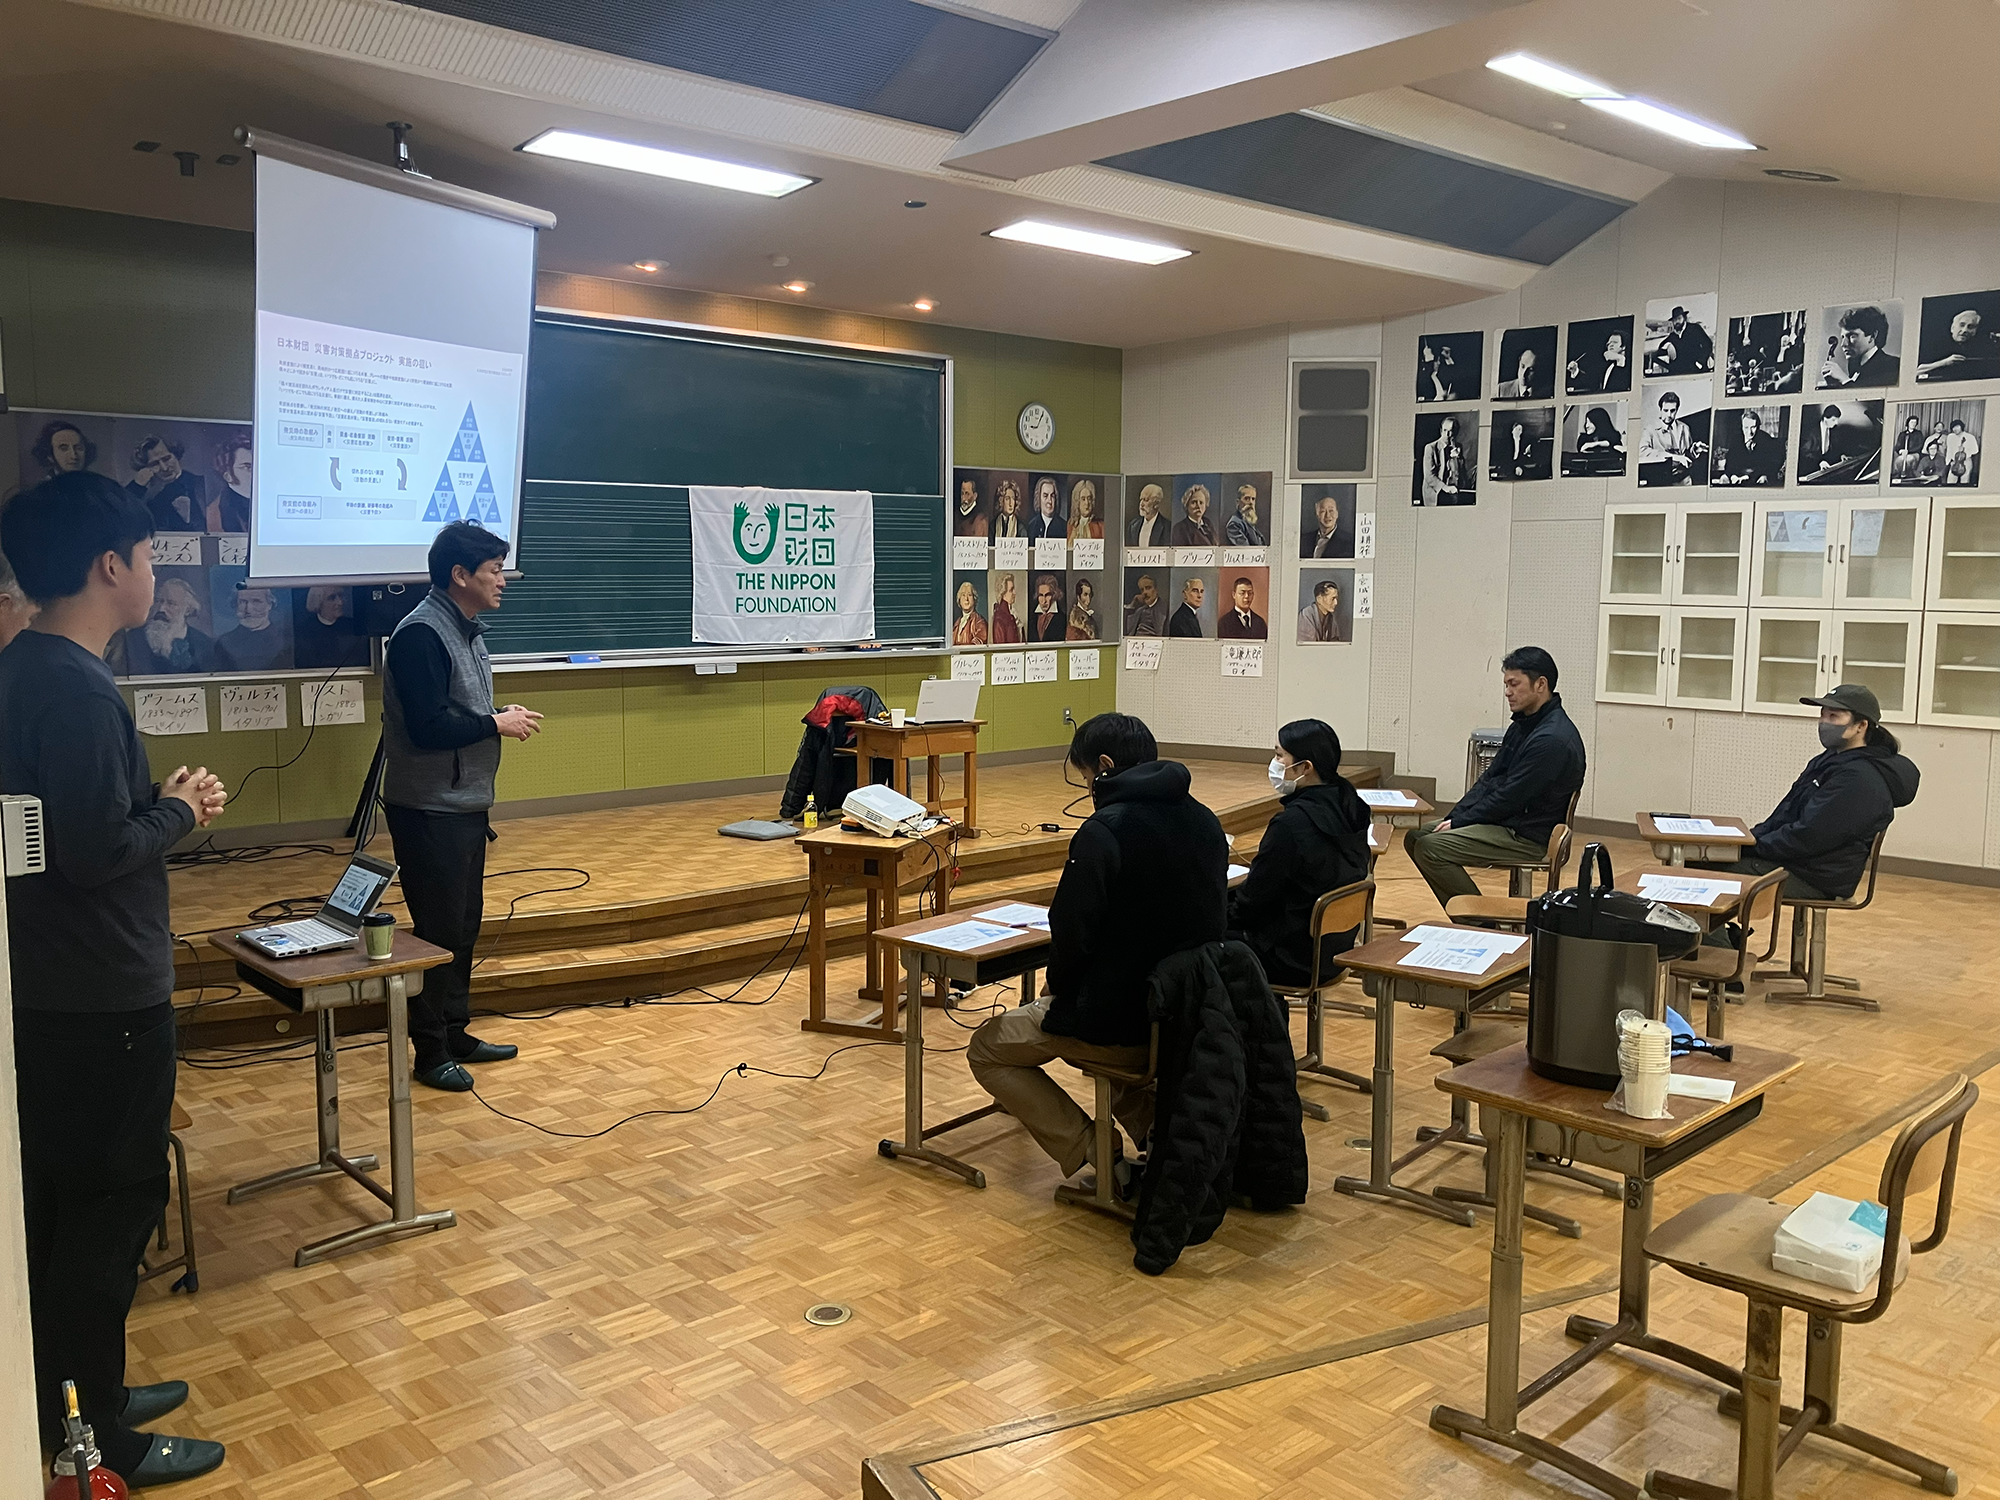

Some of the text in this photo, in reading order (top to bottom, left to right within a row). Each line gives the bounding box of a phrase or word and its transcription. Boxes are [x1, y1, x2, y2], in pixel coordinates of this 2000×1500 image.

[277, 337, 310, 352] 日本財団
[314, 342, 395, 364] 災害対策拠点プロジェクト
[784, 502, 836, 532] 日本
[784, 537, 836, 566] 財団
[735, 572, 836, 590] THE NIPPON
[735, 596, 837, 613] FOUNDATION
[139, 691, 199, 706] ブラームス
[223, 686, 280, 702] ヴェルディ
[310, 684, 350, 696] リスト
[232, 716, 274, 729] イタリア
